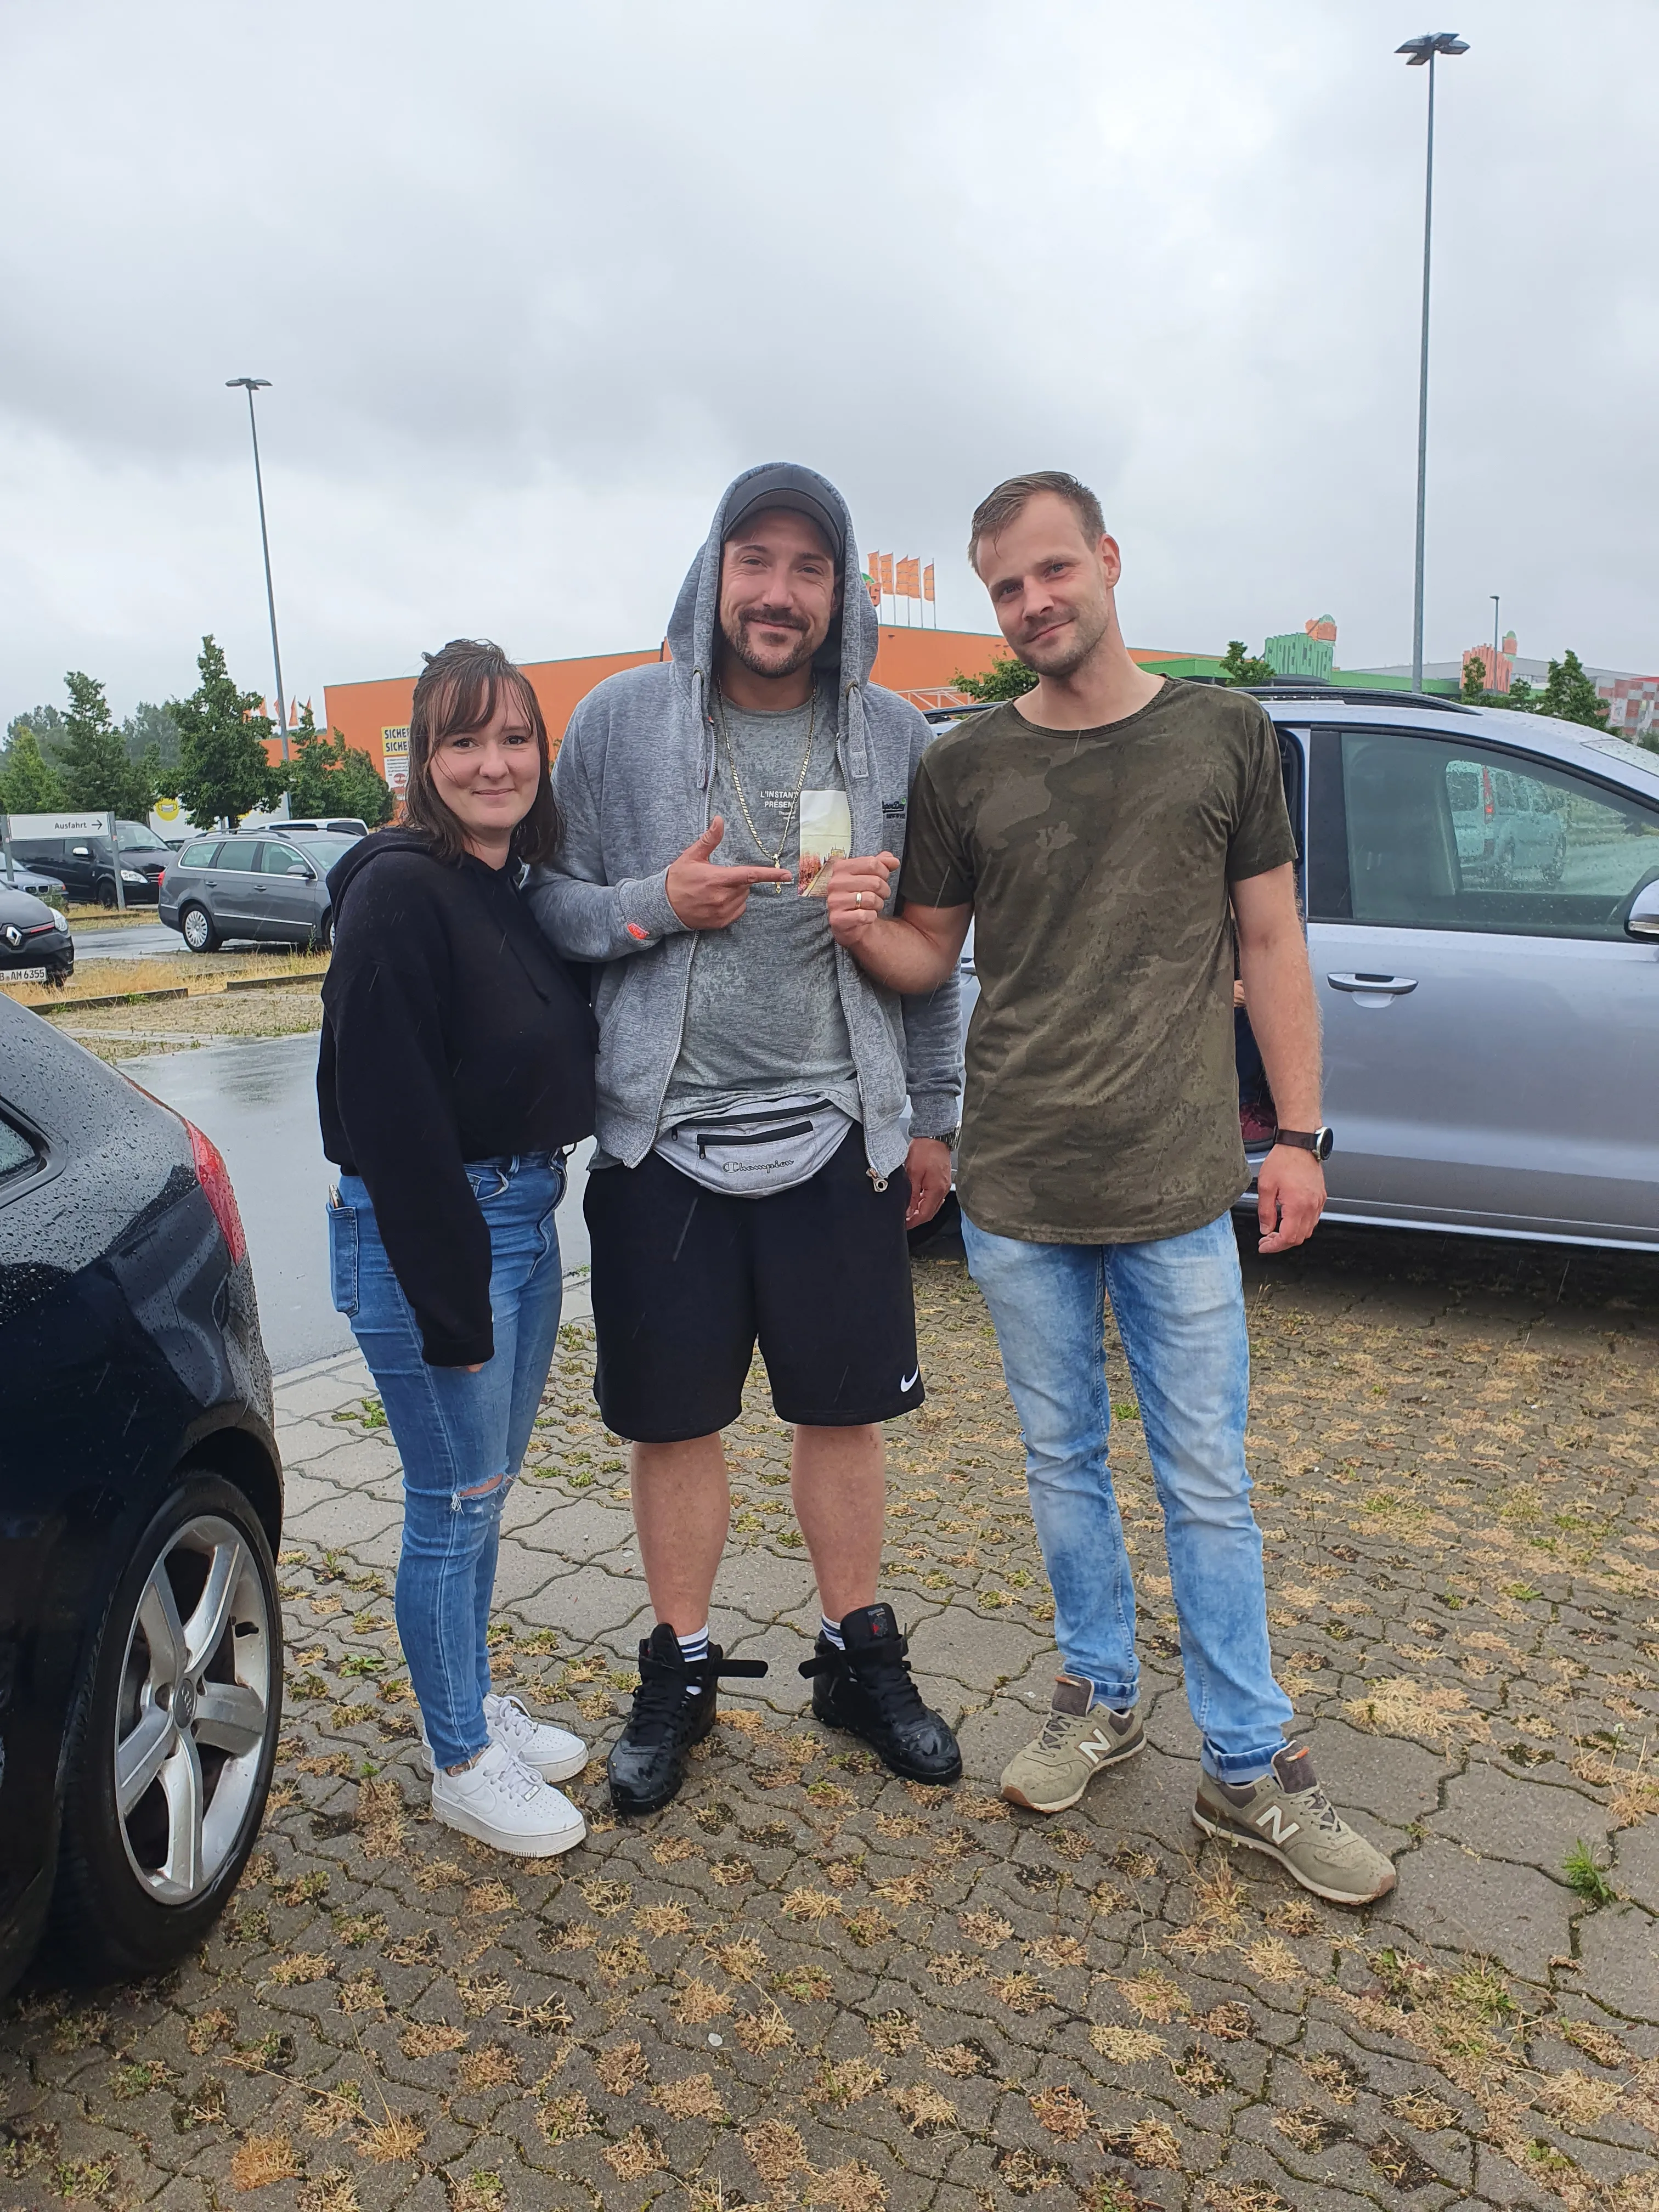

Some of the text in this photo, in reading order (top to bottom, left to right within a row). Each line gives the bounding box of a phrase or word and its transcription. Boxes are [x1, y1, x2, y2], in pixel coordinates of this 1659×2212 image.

[11, 971, 22, 980] AM
[24, 969, 44, 979] 6355
[723, 1160, 794, 1173] Champion
